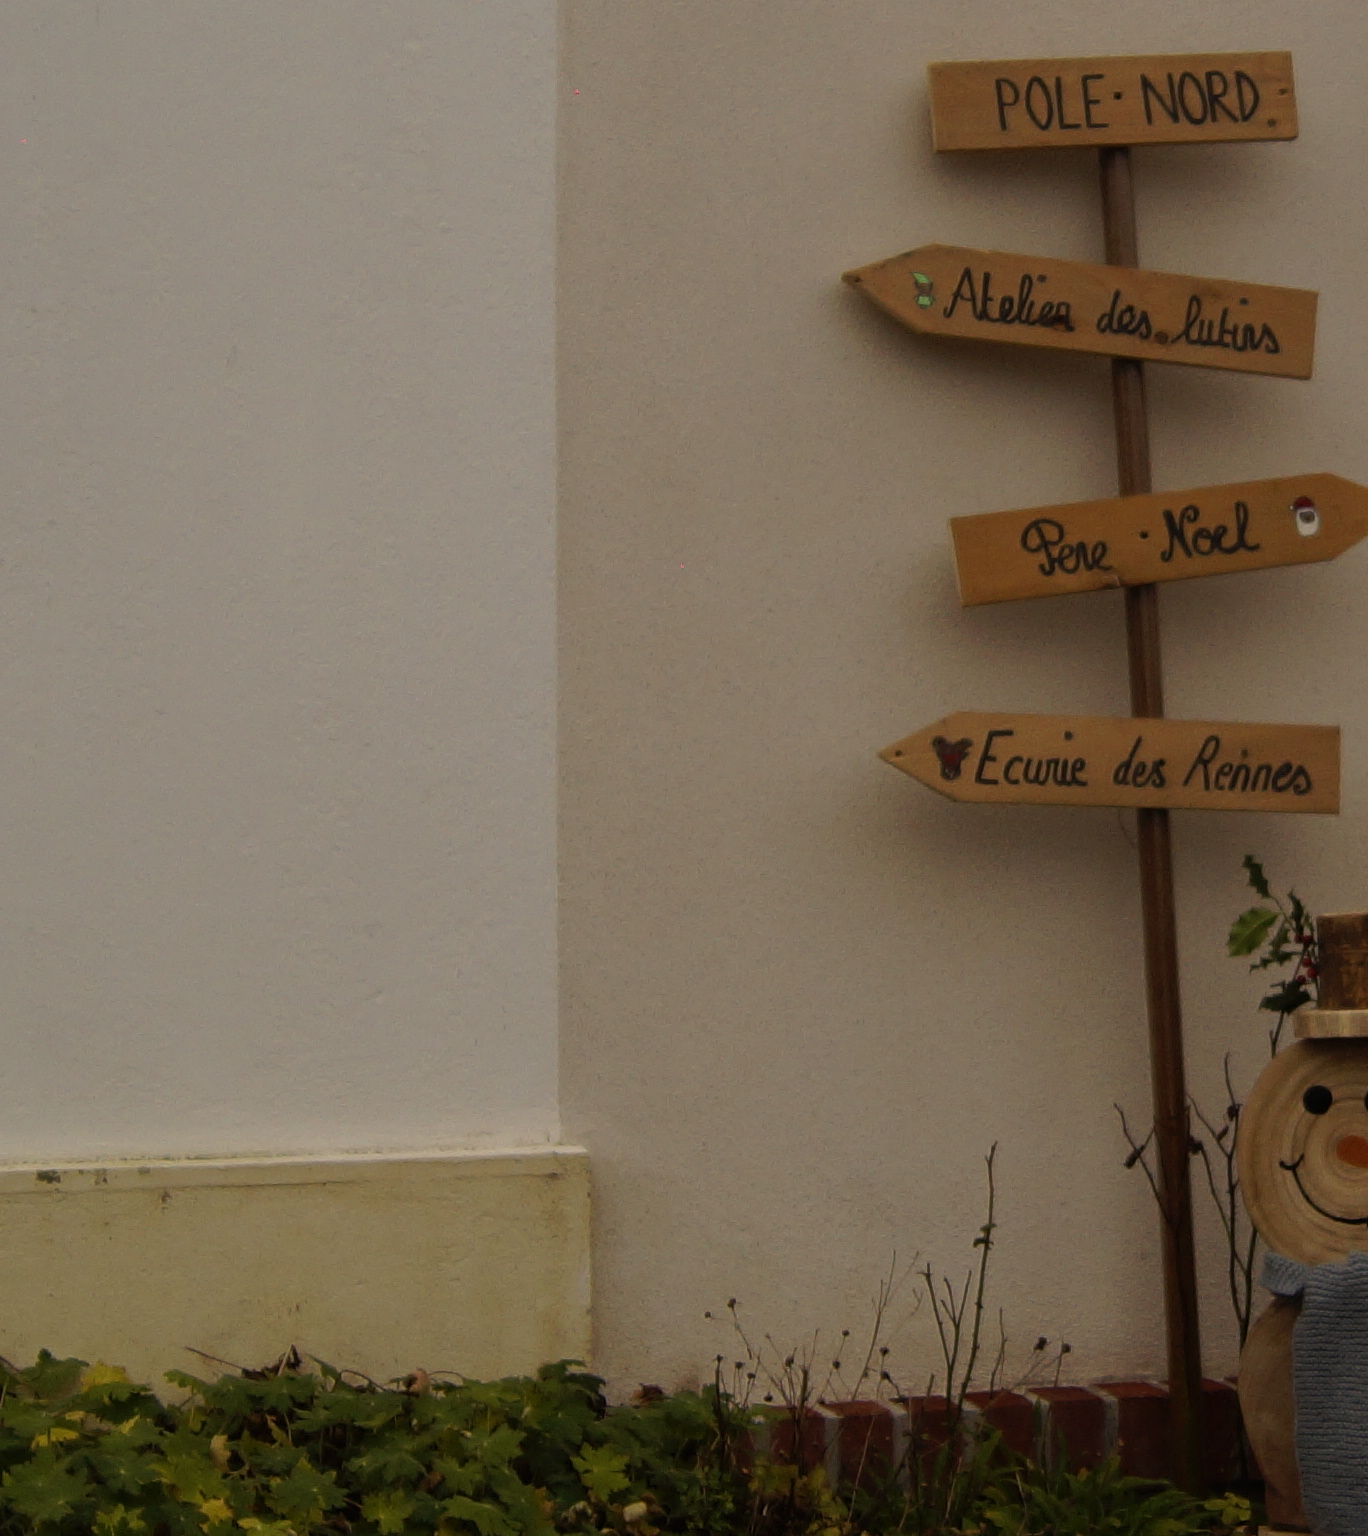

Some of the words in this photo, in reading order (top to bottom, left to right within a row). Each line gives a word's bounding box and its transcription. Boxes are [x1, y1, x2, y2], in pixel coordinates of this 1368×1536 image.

[994, 73, 1109, 132] POLE
[1140, 70, 1260, 126] NORD
[943, 266, 1075, 332] Atelier
[1097, 290, 1152, 340] des
[1171, 295, 1281, 354] lutins
[1021, 518, 1113, 576] Pere
[1161, 501, 1261, 563] Noel
[974, 729, 1088, 788] Ecurie
[1112, 735, 1167, 789] des
